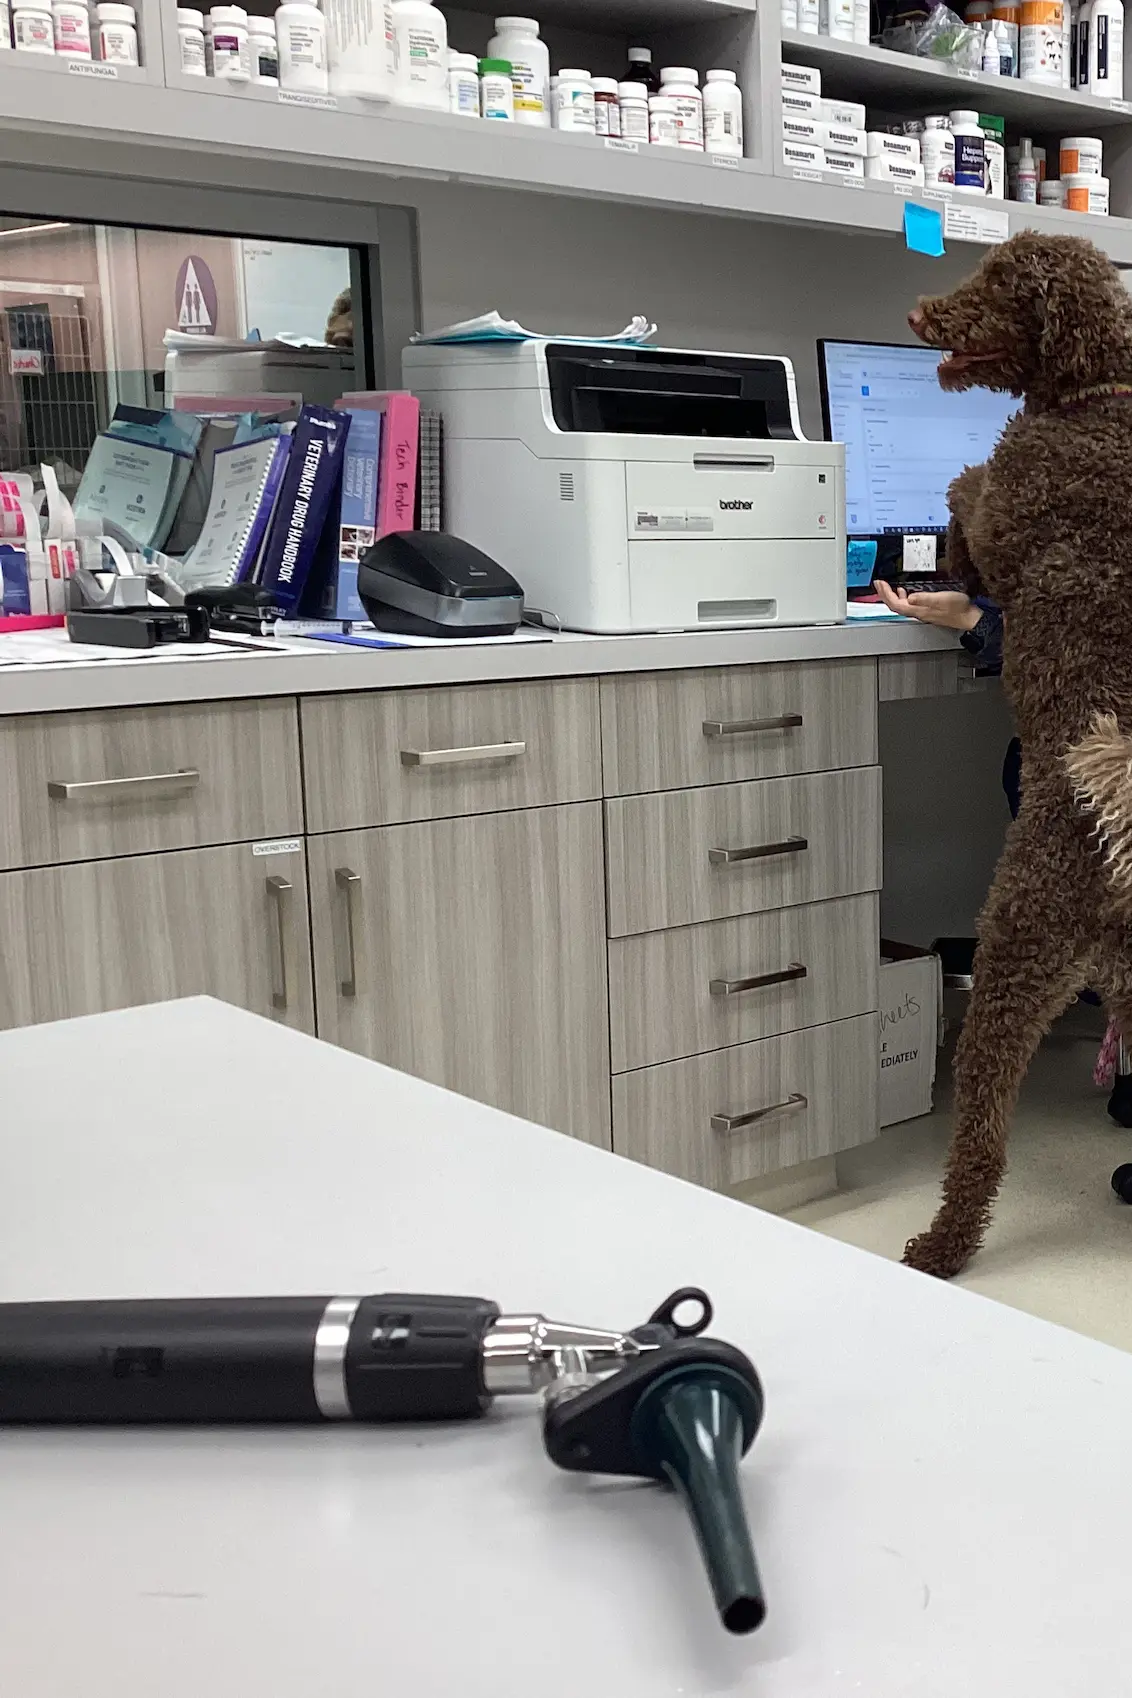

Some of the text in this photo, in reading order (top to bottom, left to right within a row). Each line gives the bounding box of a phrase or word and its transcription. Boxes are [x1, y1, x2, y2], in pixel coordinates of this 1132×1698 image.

[781, 69, 812, 81] Denamarin
[782, 96, 812, 108] Denamarin
[783, 121, 814, 134] Denamarin
[829, 131, 858, 143] Denamarin
[883, 140, 912, 152] Denamarin
[784, 147, 815, 159] Denamarin
[826, 156, 855, 168] Denamarin
[889, 164, 916, 176] Denamarin
[297, 438, 324, 501] VETERINARY
[353, 457, 365, 500] Veterinary
[396, 440, 408, 521] Tech Binder
[719, 499, 754, 510] brother
[290, 499, 309, 529] DRUG
[278, 527, 303, 584] HANDBOOK
[254, 842, 300, 854] OVERSTOCK
